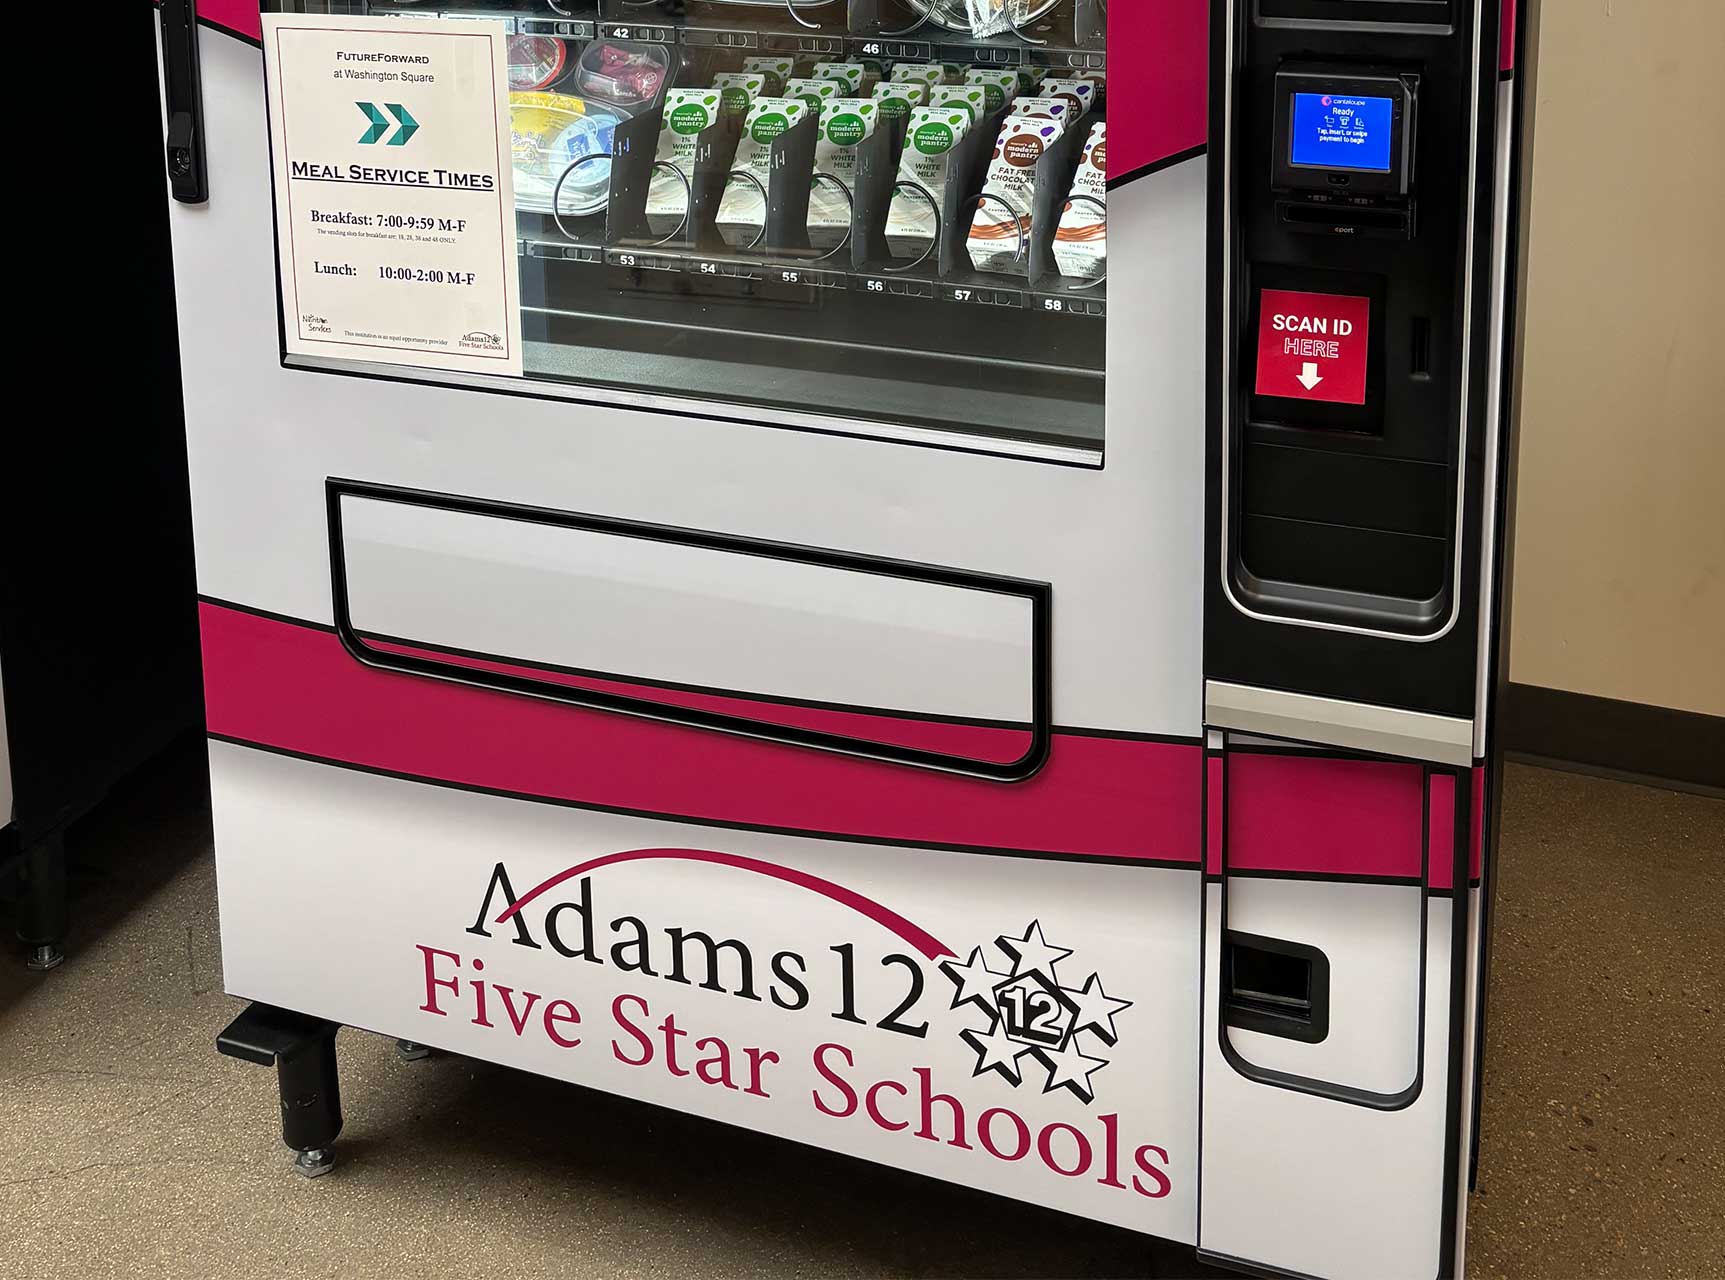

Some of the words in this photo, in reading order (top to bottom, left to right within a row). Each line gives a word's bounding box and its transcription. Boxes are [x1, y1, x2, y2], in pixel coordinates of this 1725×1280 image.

[613, 28, 629, 38] 42
[862, 43, 879, 55] 46
[334, 70, 343, 79] at
[345, 69, 398, 82] Washington
[401, 71, 434, 82] Square
[1333, 107, 1354, 117] Ready
[292, 161, 345, 180] MEAL
[350, 164, 430, 184] SERVICE
[433, 170, 494, 188] TIMES
[1004, 183, 1023, 191] MILK
[310, 210, 373, 226] Breakfast:
[377, 215, 434, 230] 7:00-9:59
[438, 219, 466, 232] M-F
[620, 255, 635, 266] 53
[314, 261, 357, 276] Lunch:
[379, 266, 443, 283] 10:00-2:00
[447, 271, 475, 285] M-F
[700, 263, 716, 274] 54
[782, 271, 798, 282] 55
[866, 280, 883, 291] 56
[954, 289, 971, 301] 57
[1044, 299, 1062, 311] 58
[1272, 314, 1327, 333] SCAN
[1334, 319, 1352, 336] ID
[1284, 337, 1339, 358] HERE
[465, 860, 931, 1039] Adams12
[1001, 985, 1065, 1042] 12
[415, 943, 582, 1049] Five
[609, 993, 780, 1099] Star
[812, 1041, 1174, 1199] Schools
